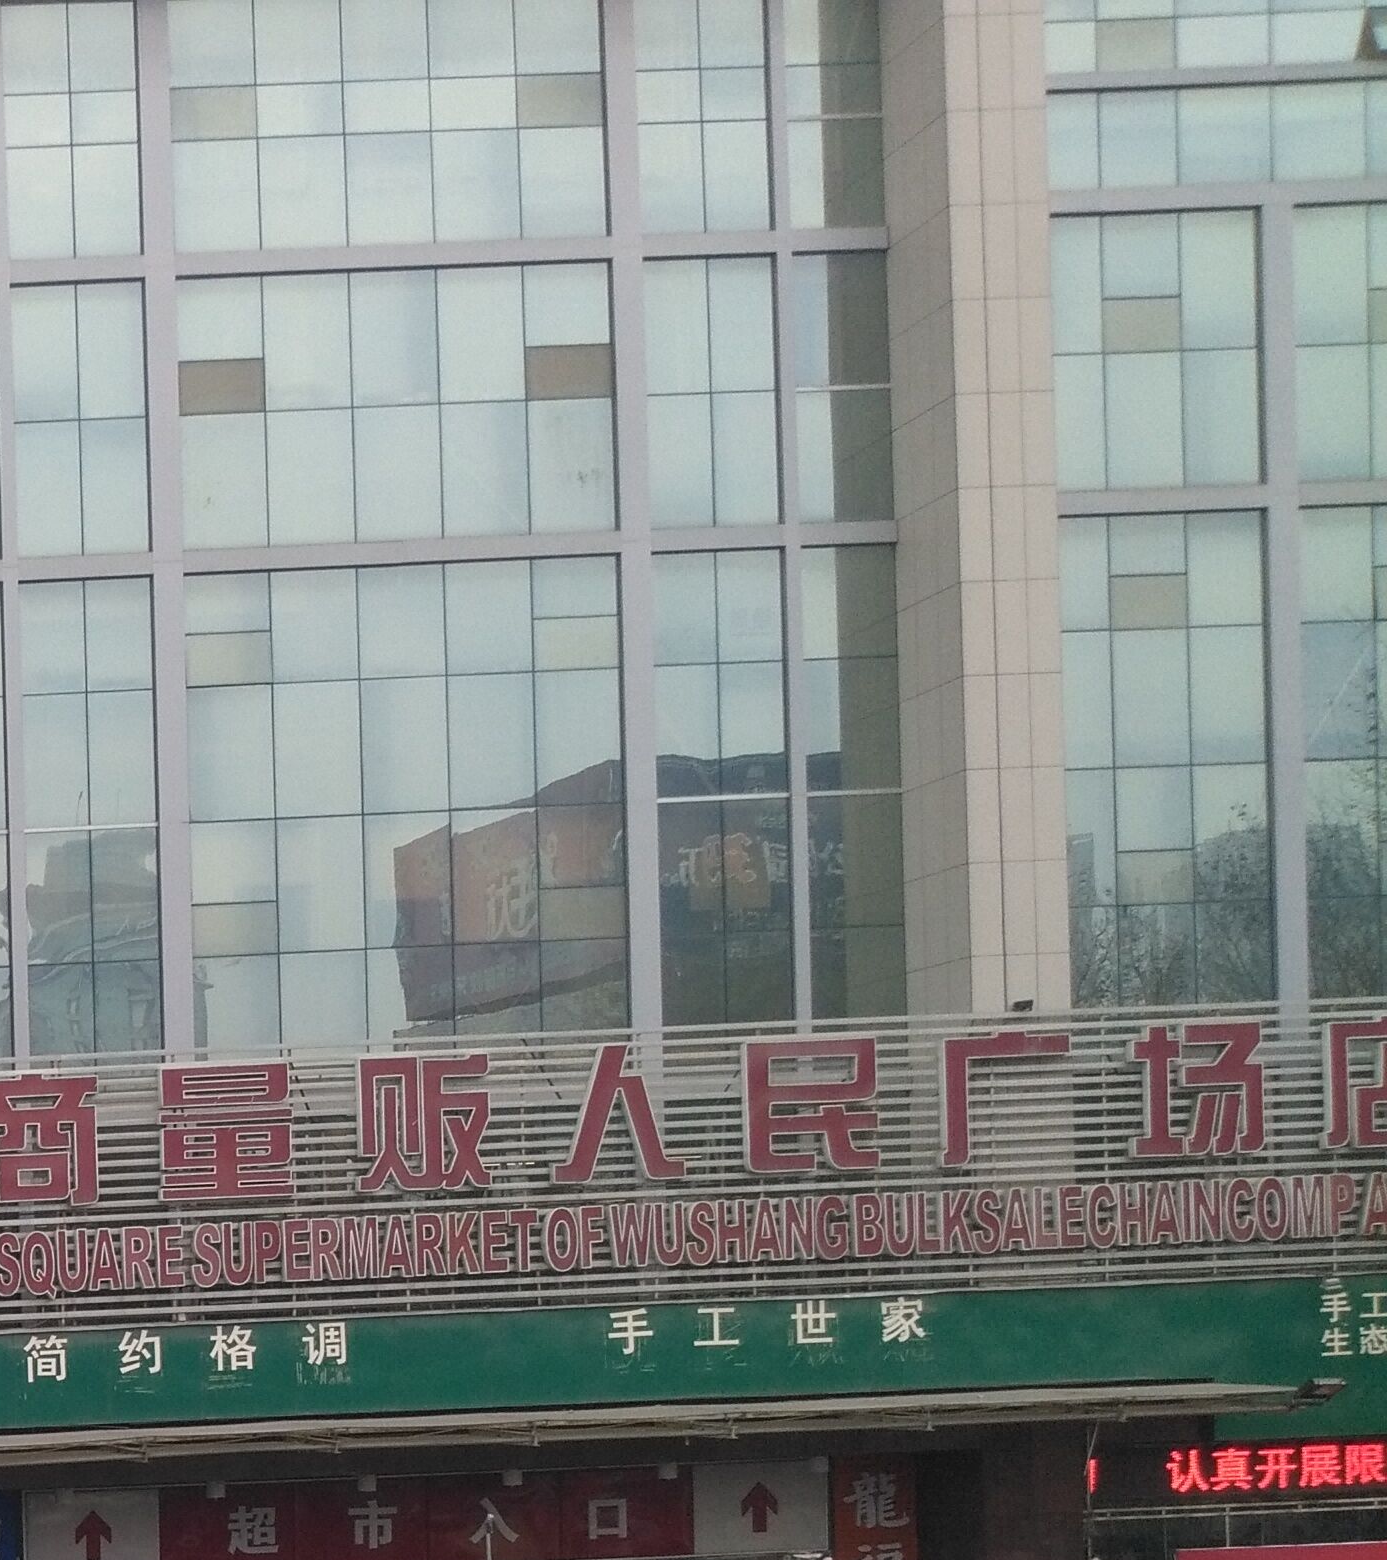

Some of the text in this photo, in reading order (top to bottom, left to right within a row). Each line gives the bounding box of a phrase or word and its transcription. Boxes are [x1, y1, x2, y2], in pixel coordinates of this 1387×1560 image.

[23, 1321, 349, 1384] 简约格调
[608, 1296, 926, 1355] 手工世家
[1165, 1443, 1387, 1493] 认真开展限
[227, 1497, 628, 1555] 超市入口
